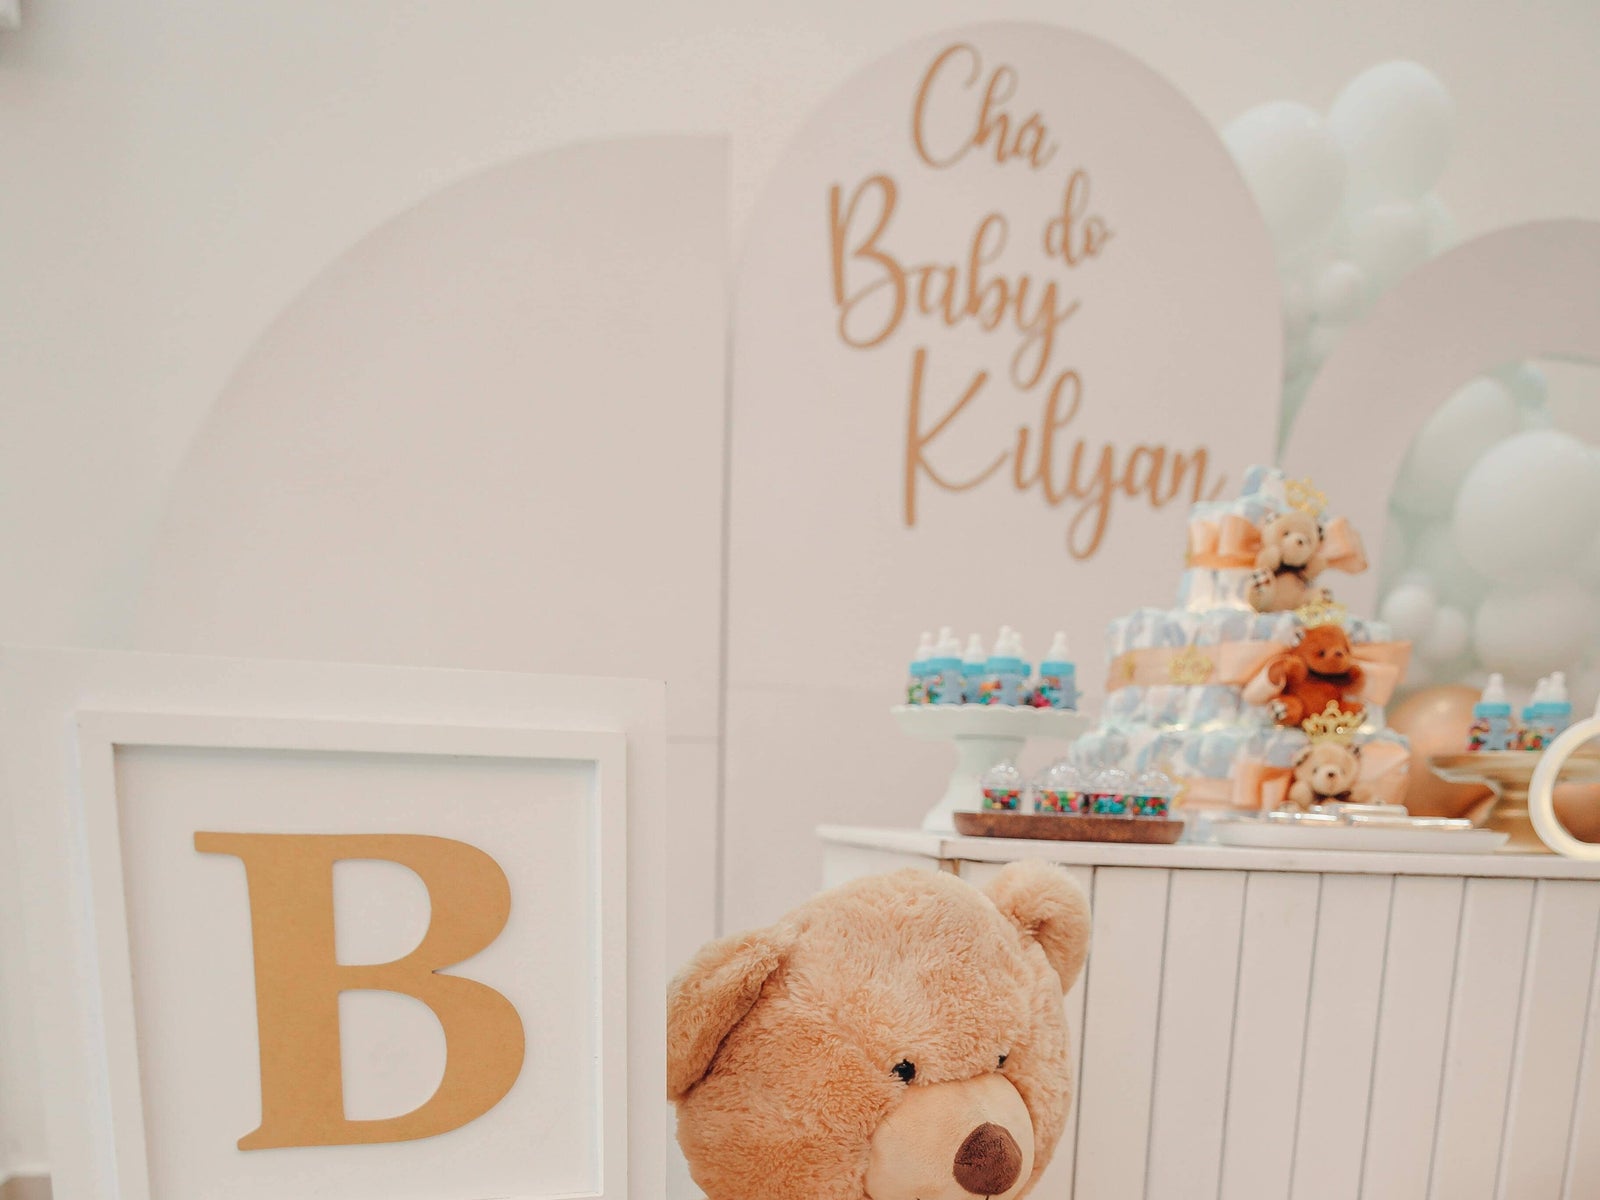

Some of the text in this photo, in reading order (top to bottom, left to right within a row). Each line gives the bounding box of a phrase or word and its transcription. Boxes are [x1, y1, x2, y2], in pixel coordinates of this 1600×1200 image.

[829, 174, 1080, 391] Baby
[1043, 169, 1114, 267] do
[903, 347, 1227, 560] Kilyan
